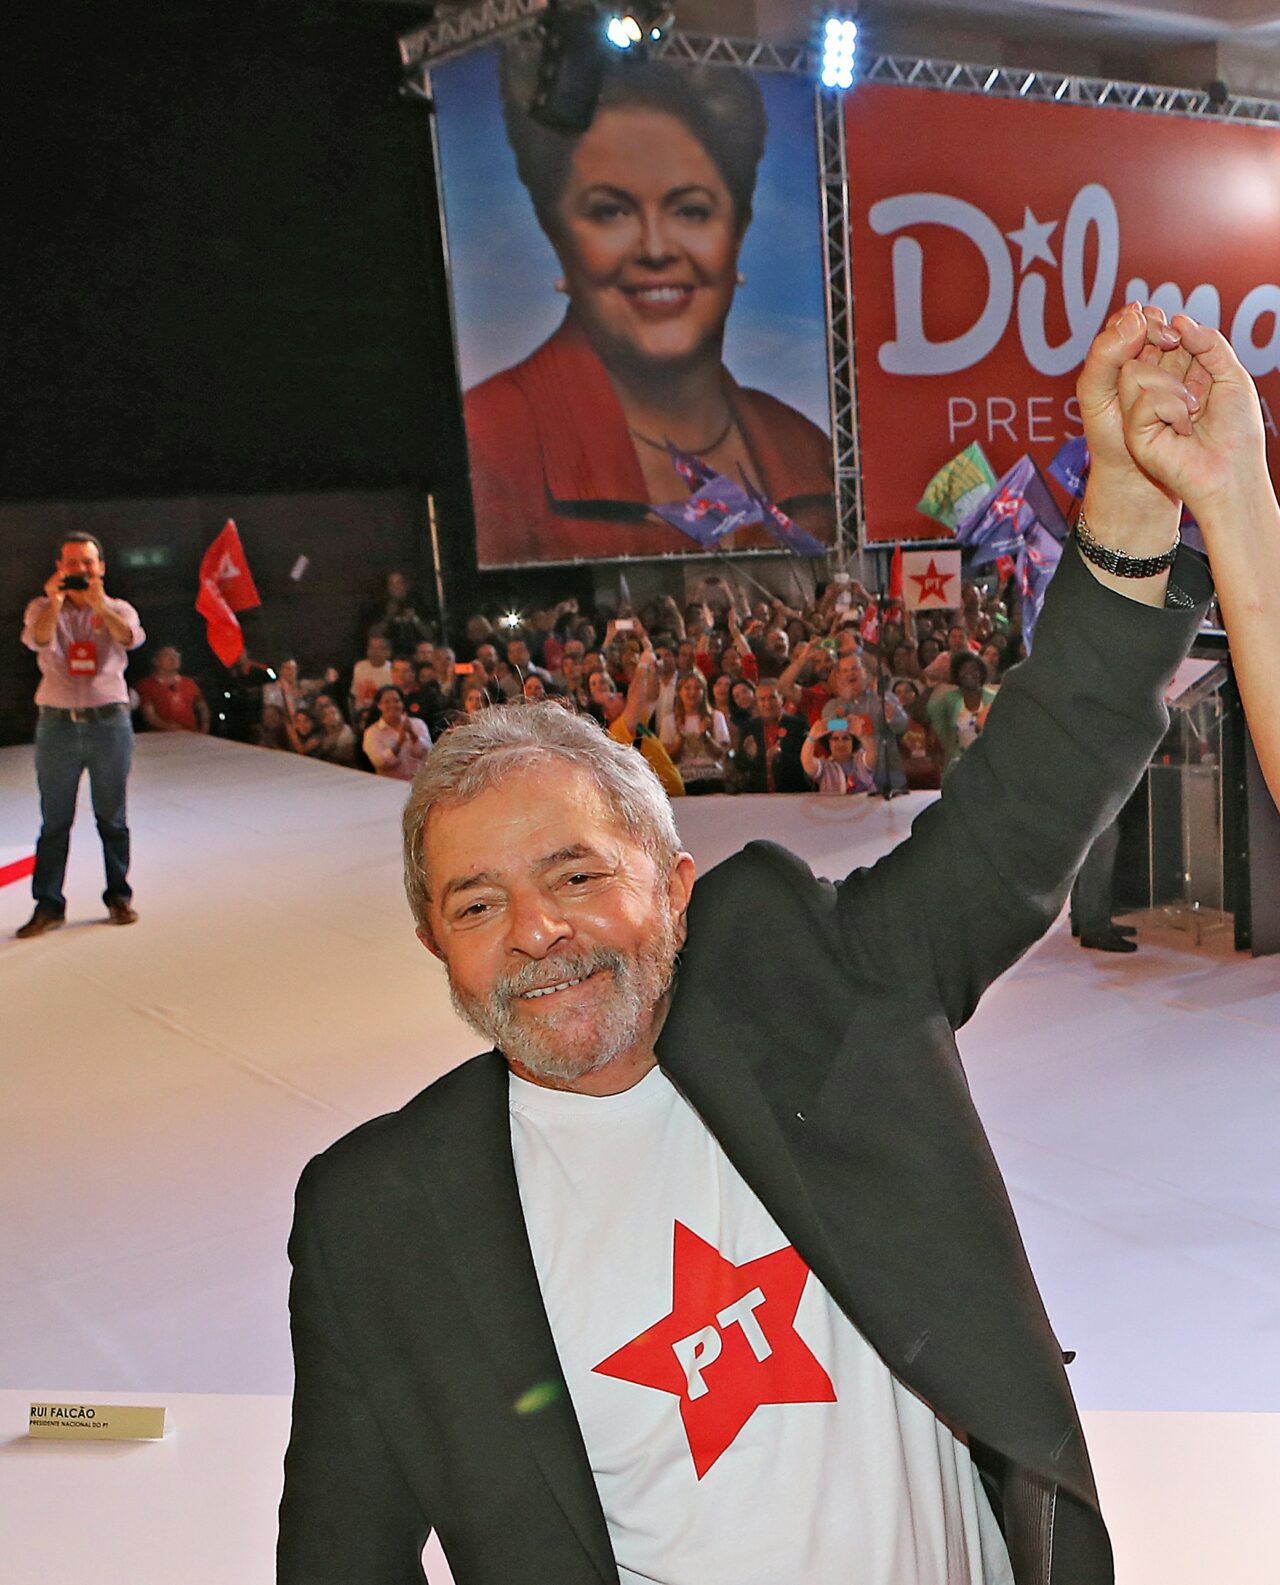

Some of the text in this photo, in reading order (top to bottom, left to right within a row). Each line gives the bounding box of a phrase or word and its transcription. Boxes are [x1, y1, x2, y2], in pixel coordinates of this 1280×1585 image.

[671, 1286, 767, 1402] PT
[30, 1406, 96, 1419] RUI FALCÃO
